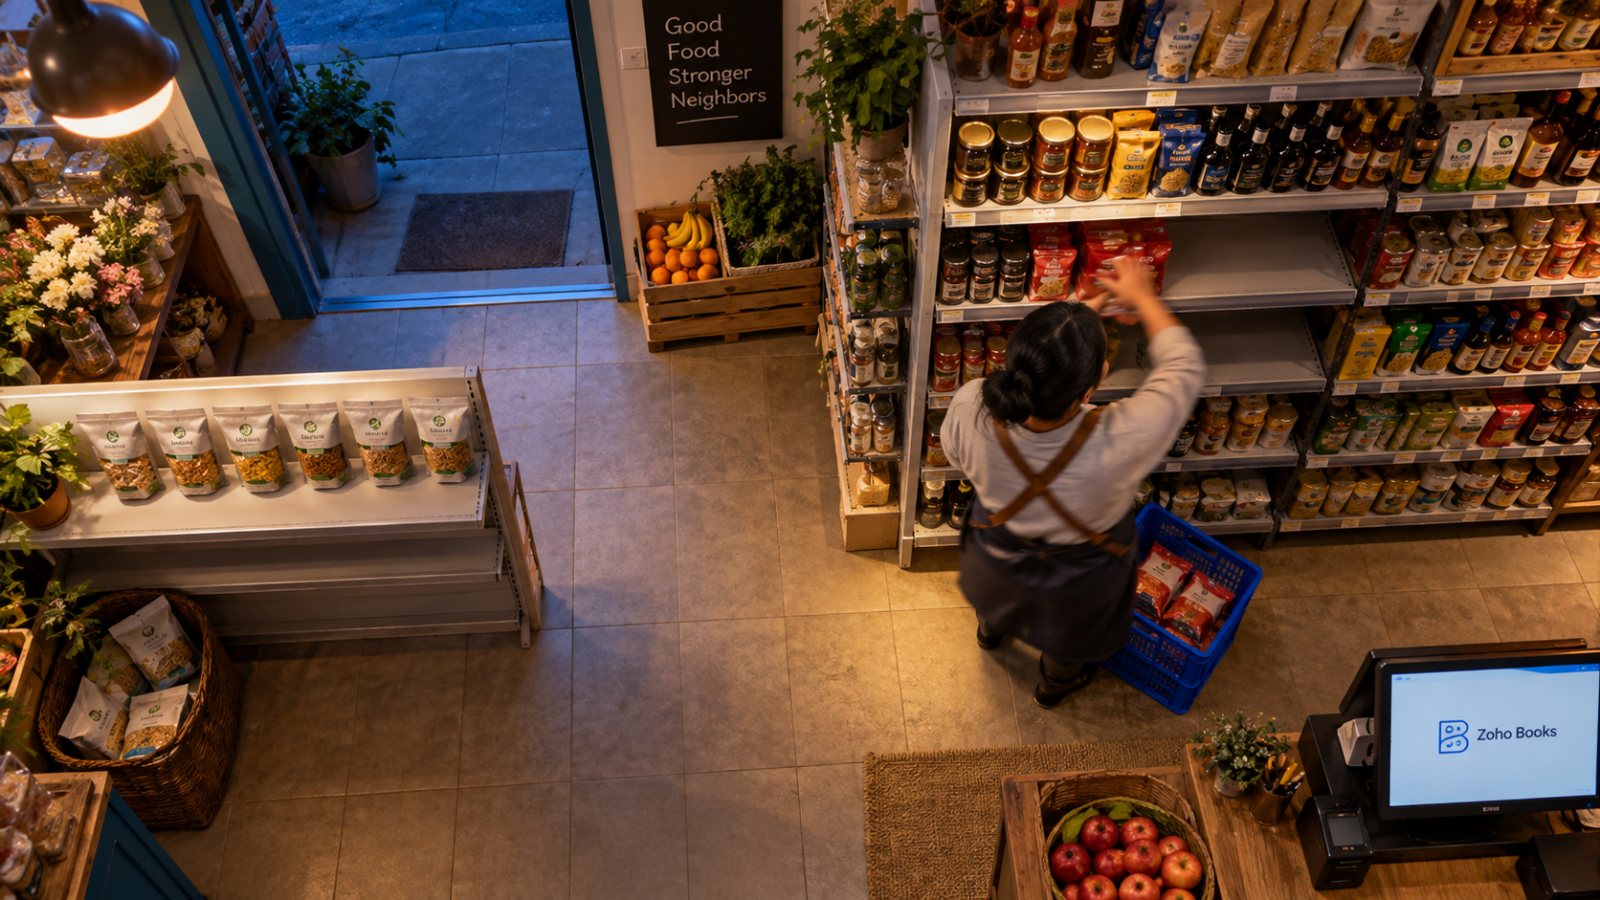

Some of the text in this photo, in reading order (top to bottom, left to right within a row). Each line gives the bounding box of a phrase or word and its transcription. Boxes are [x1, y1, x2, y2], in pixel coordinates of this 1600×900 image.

[664, 13, 723, 35] Good
[667, 39, 720, 61] Food
[669, 67, 753, 86] Stronger
[671, 88, 767, 111] Neighbors
[1476, 726, 1513, 741] Zoho
[1515, 724, 1557, 740] Books
